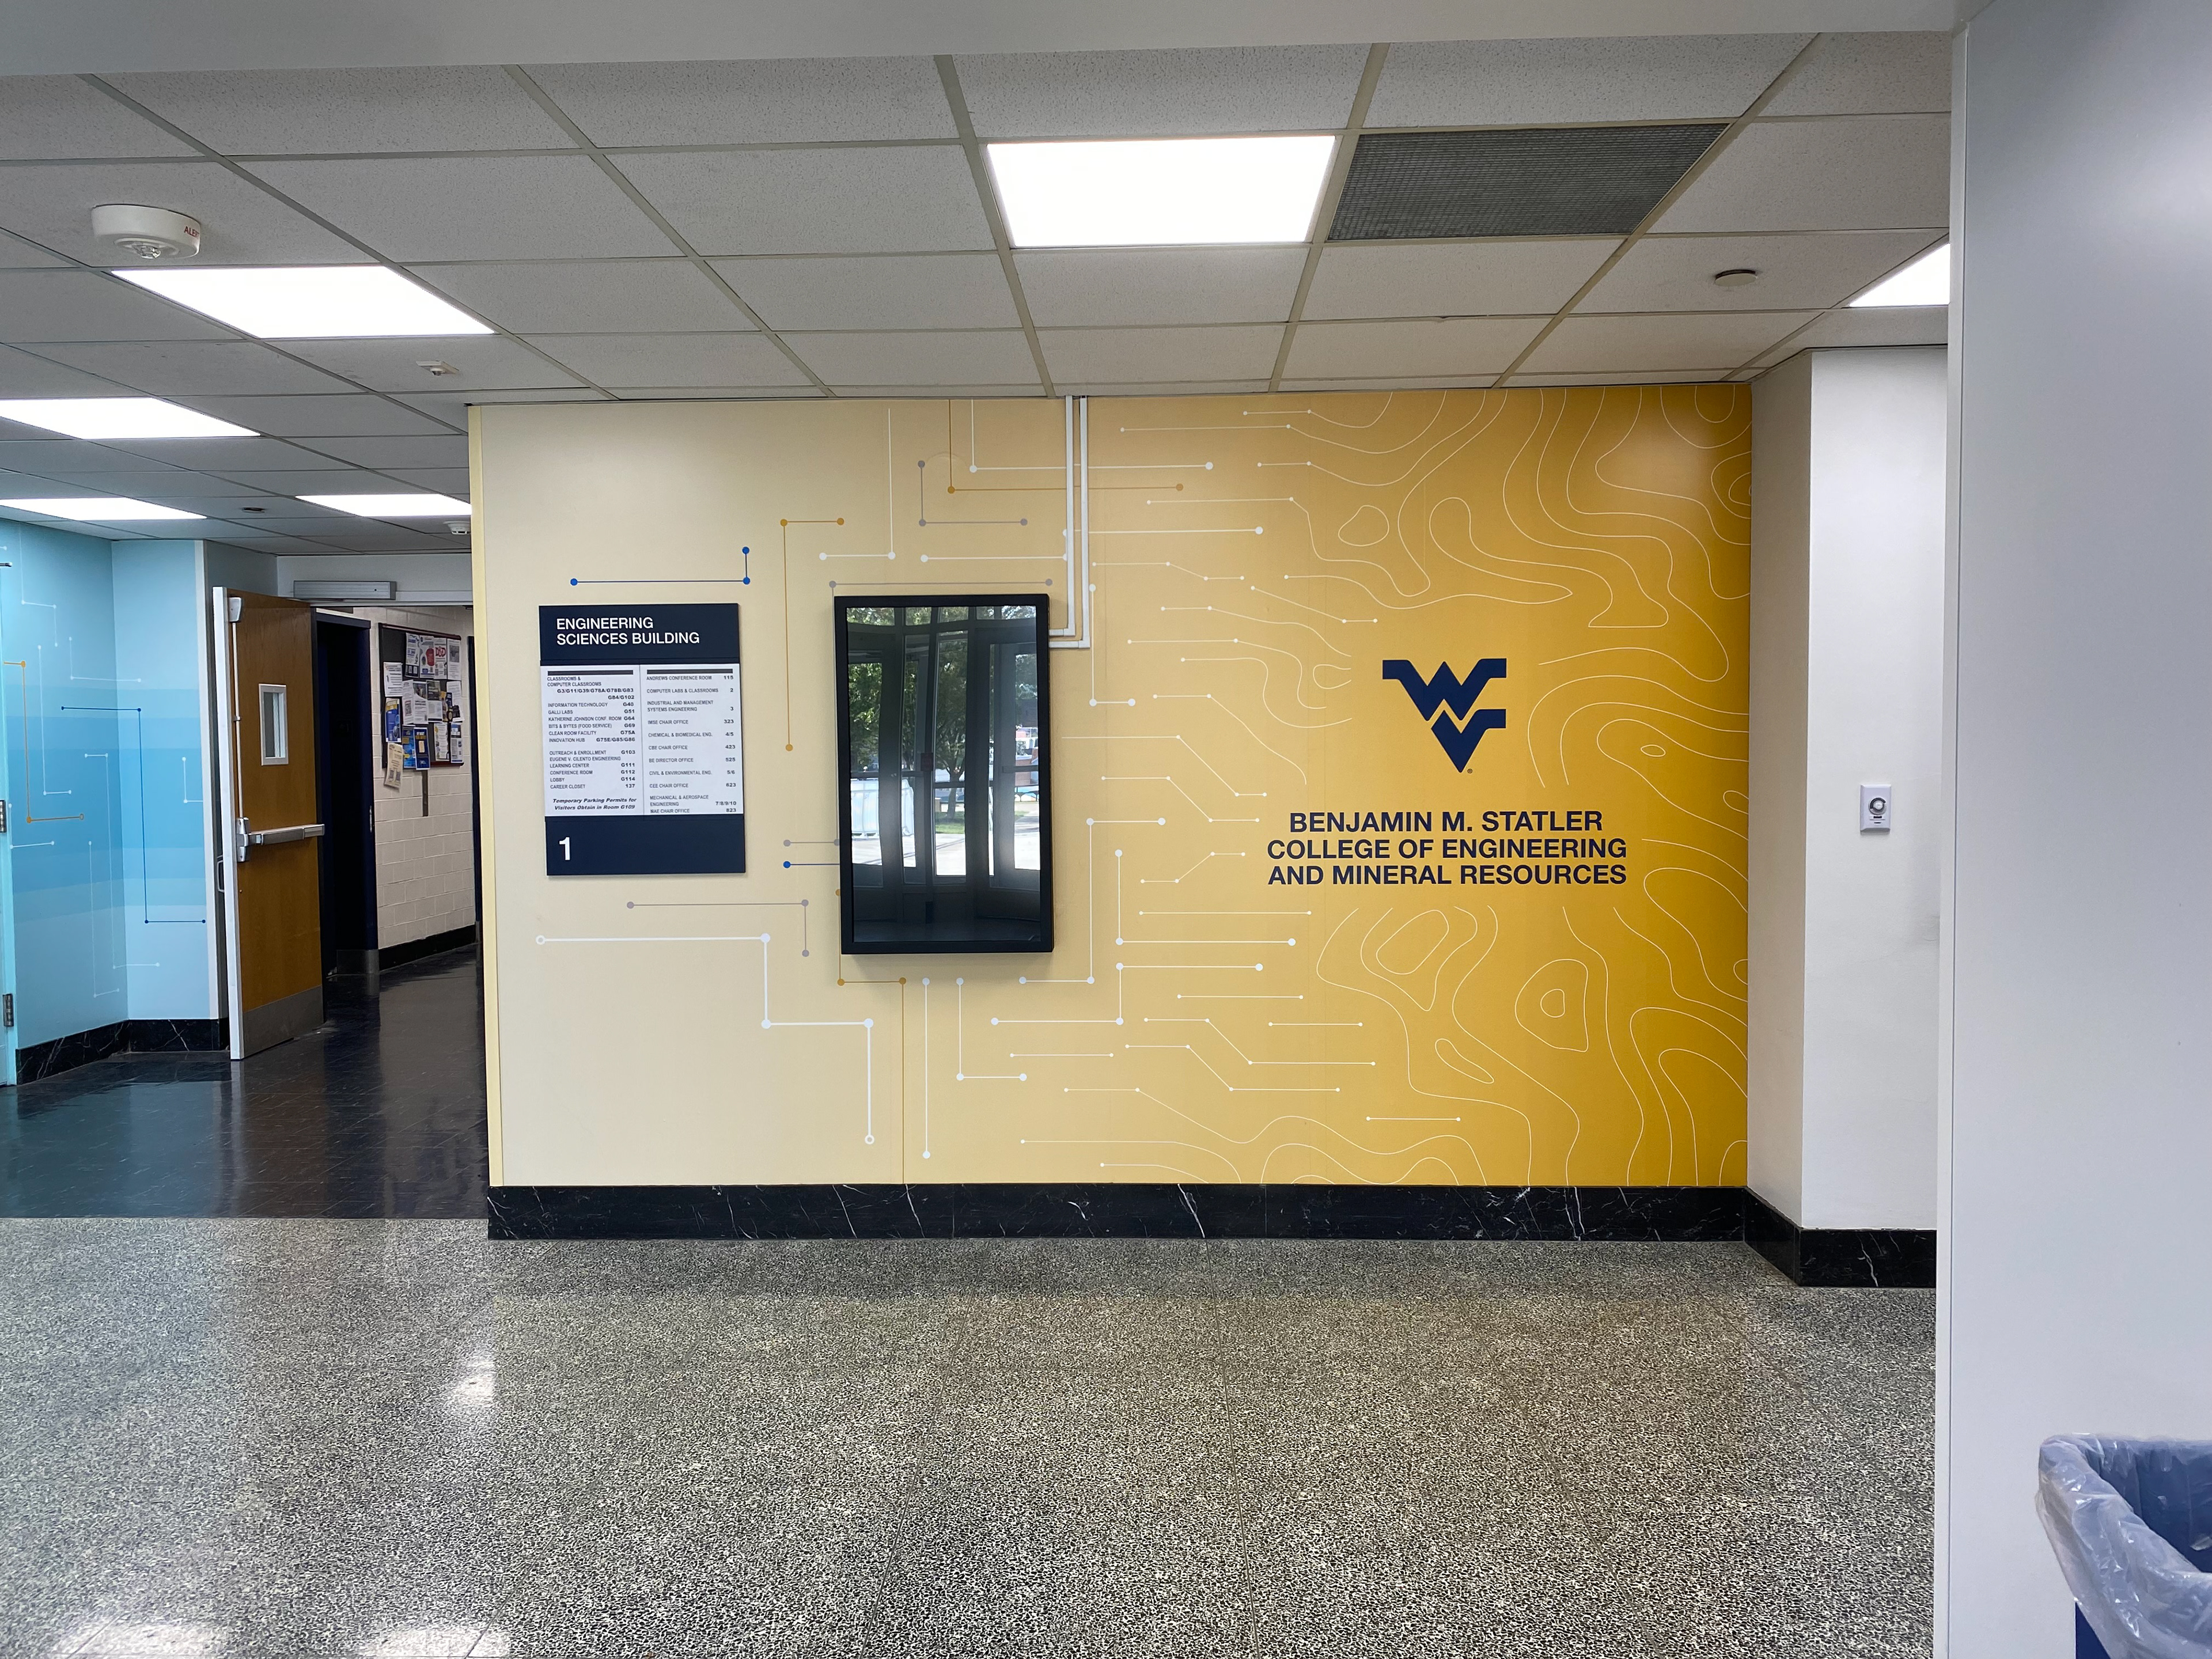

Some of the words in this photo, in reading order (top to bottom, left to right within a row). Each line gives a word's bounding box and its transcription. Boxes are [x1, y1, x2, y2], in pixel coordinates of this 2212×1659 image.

[556, 618, 653, 629] ENGINEERING
[556, 634, 628, 645] SCIENCES
[632, 632, 699, 643] BUILDING
[1290, 811, 1432, 833] BENJAMIN
[1442, 811, 1472, 831] M.
[1482, 810, 1603, 832] STATLER
[559, 837, 571, 861] 1
[1267, 839, 1390, 859] COLLEGE
[1399, 839, 1434, 859] OF
[1442, 838, 1626, 858] ENGINEERING
[1268, 865, 1323, 885] AND
[1333, 865, 1452, 885] MINERAL
[1460, 864, 1626, 885] RESOURCES
